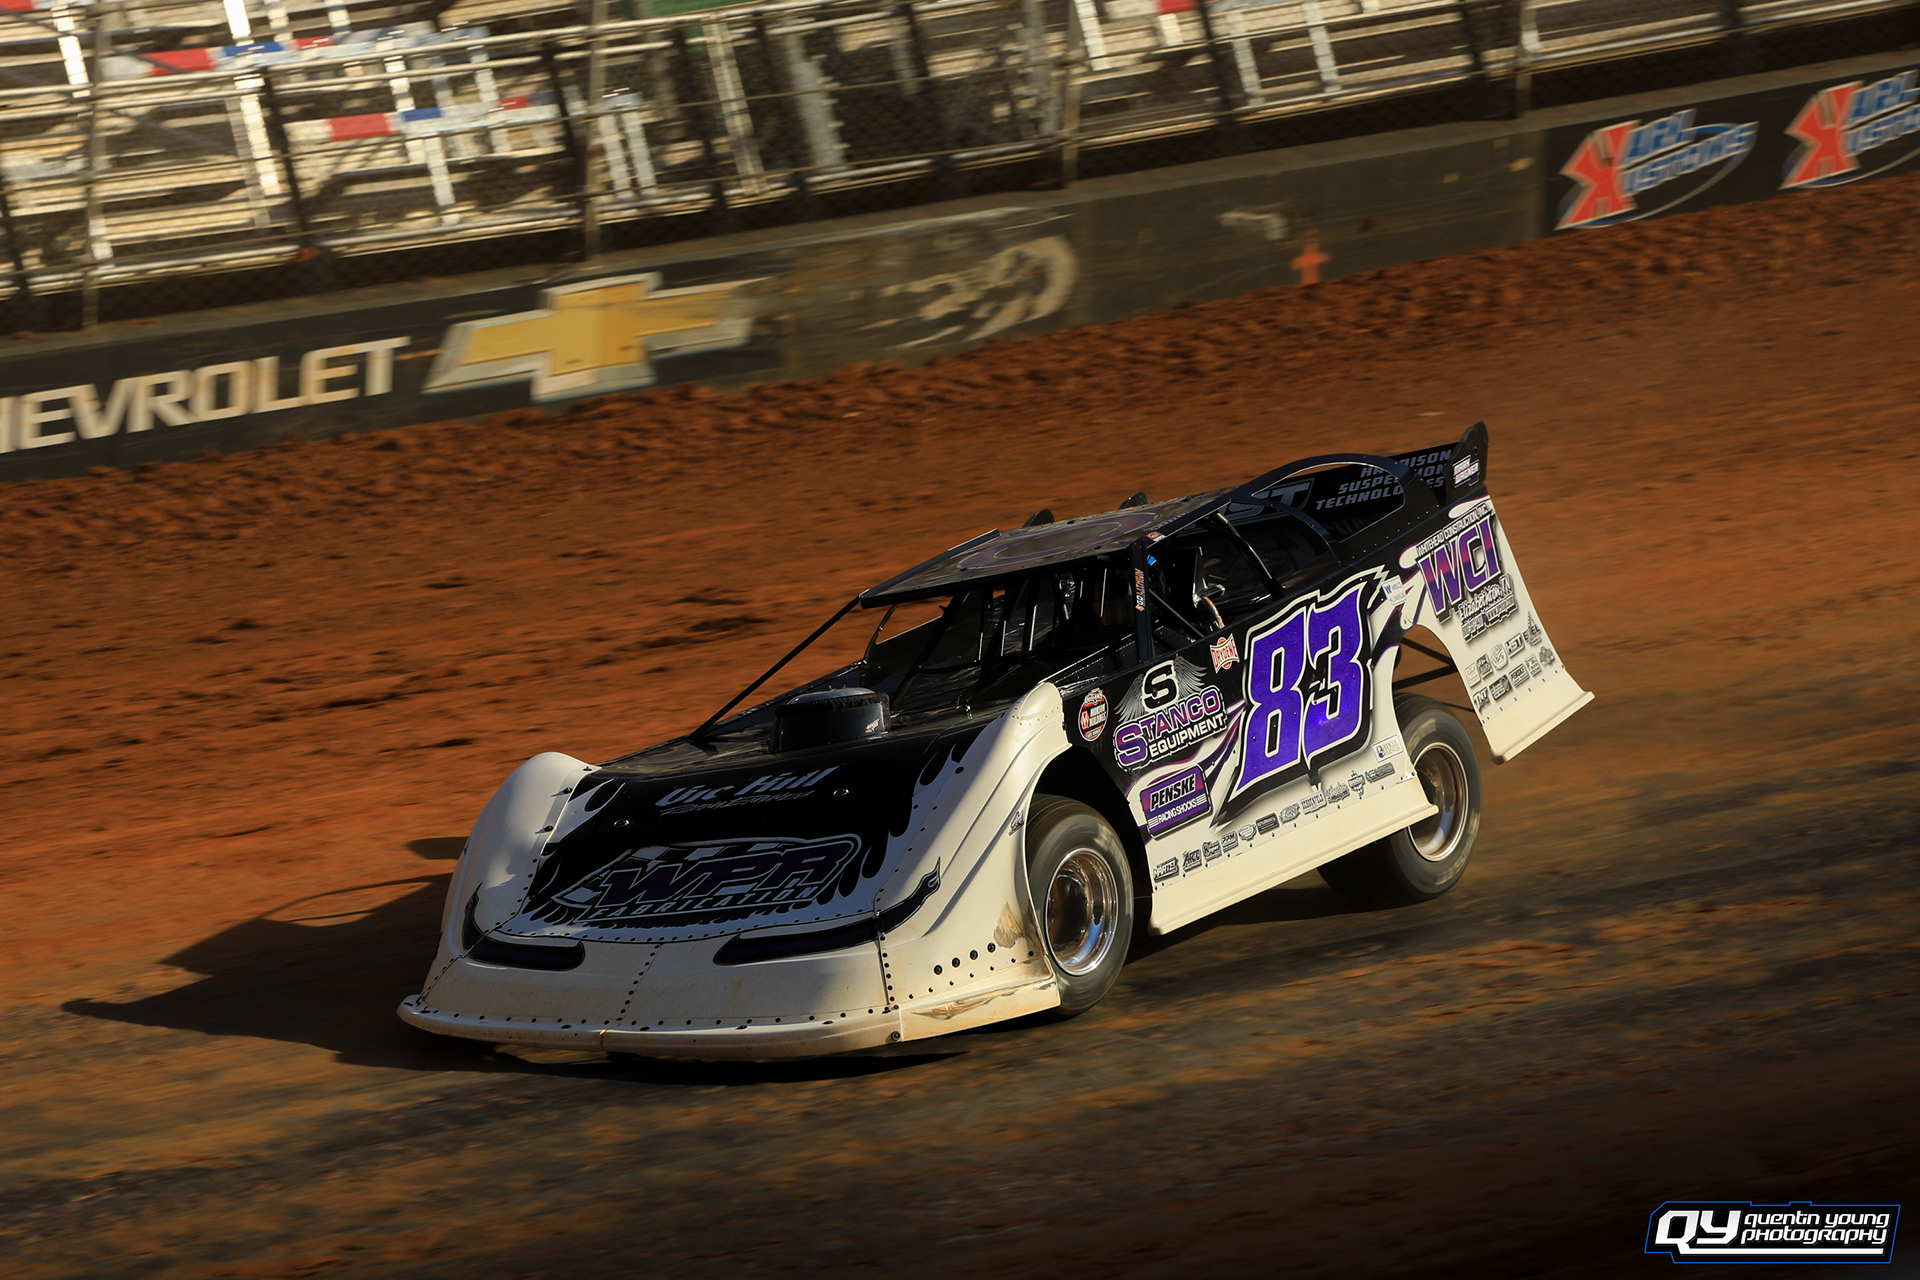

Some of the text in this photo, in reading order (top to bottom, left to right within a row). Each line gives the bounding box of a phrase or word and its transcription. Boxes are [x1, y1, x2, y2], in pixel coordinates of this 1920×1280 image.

[1316, 477, 1445, 511] TECHNOLOES
[1417, 515, 1501, 617] WCI
[1235, 584, 1366, 792] 83
[1115, 688, 1221, 766] STANCO
[1149, 713, 1225, 757] EQUIPMENT
[734, 766, 840, 796] Hill
[1150, 773, 1196, 811] PENSKE
[1157, 799, 1197, 824] RACING SHOCKS
[595, 842, 852, 908] WPR
[588, 886, 819, 919] FABRICATION
